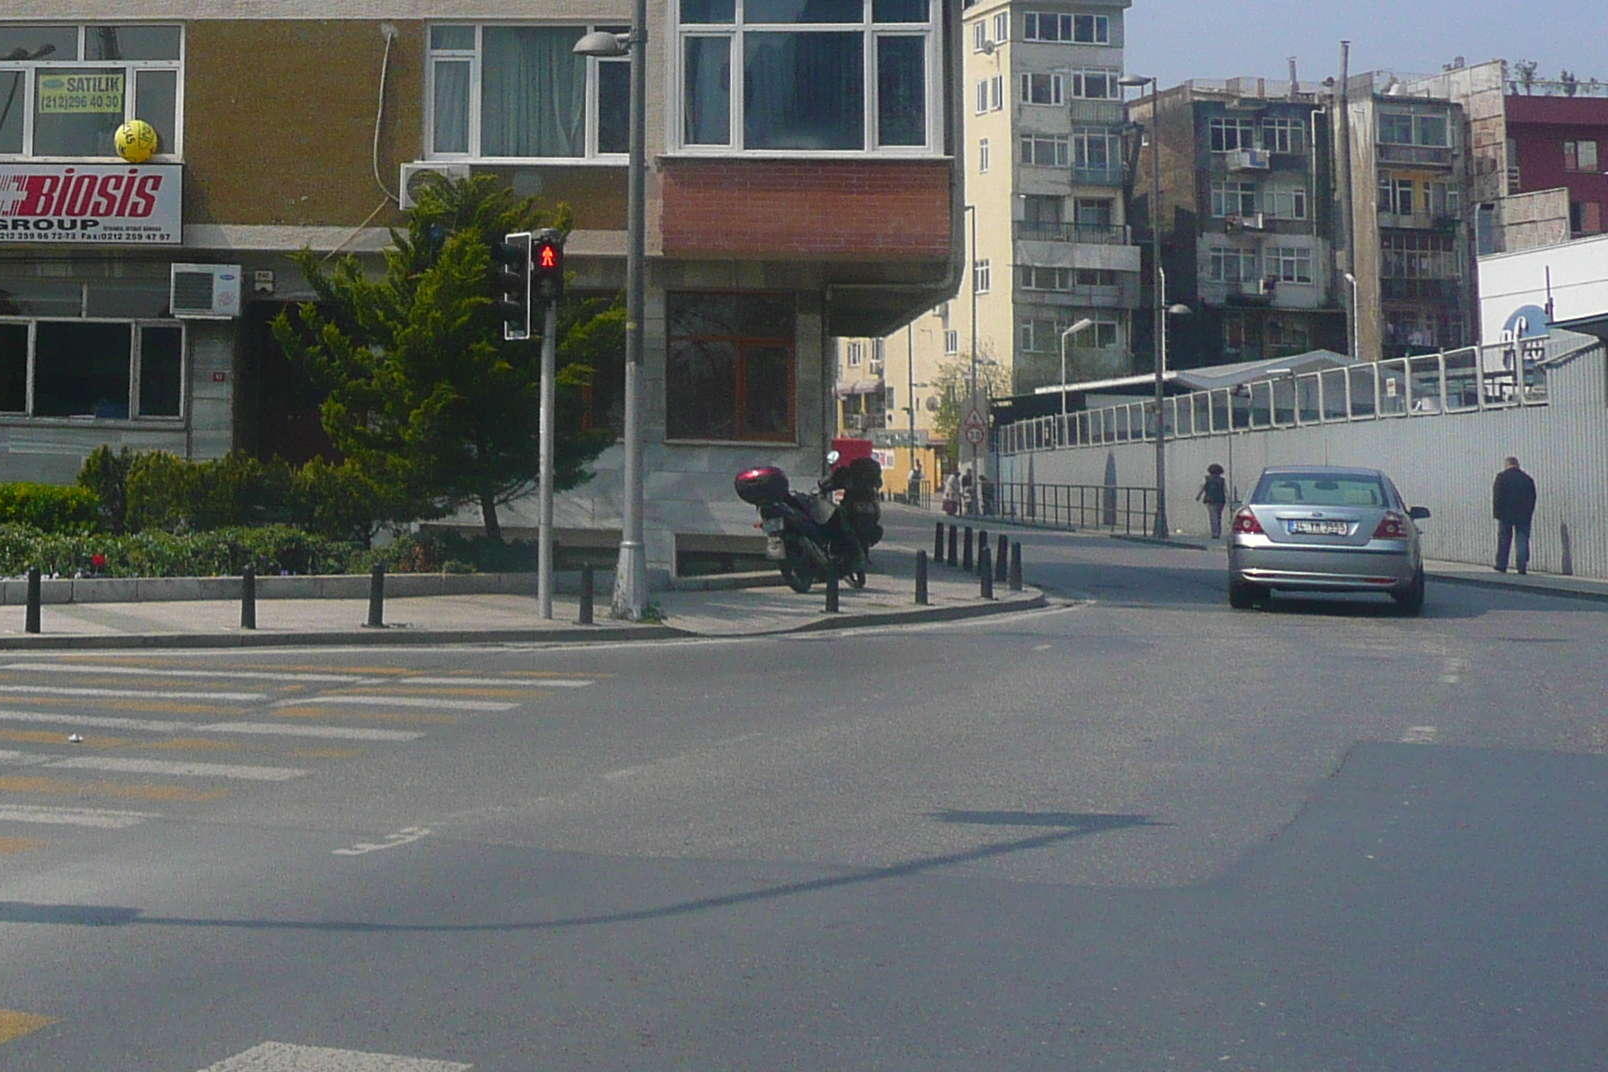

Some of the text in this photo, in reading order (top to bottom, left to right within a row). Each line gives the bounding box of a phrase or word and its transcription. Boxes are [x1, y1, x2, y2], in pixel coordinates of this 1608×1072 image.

[67, 77, 120, 92] SATILIK
[90, 96, 103, 108] 40
[105, 95, 119, 107] 30
